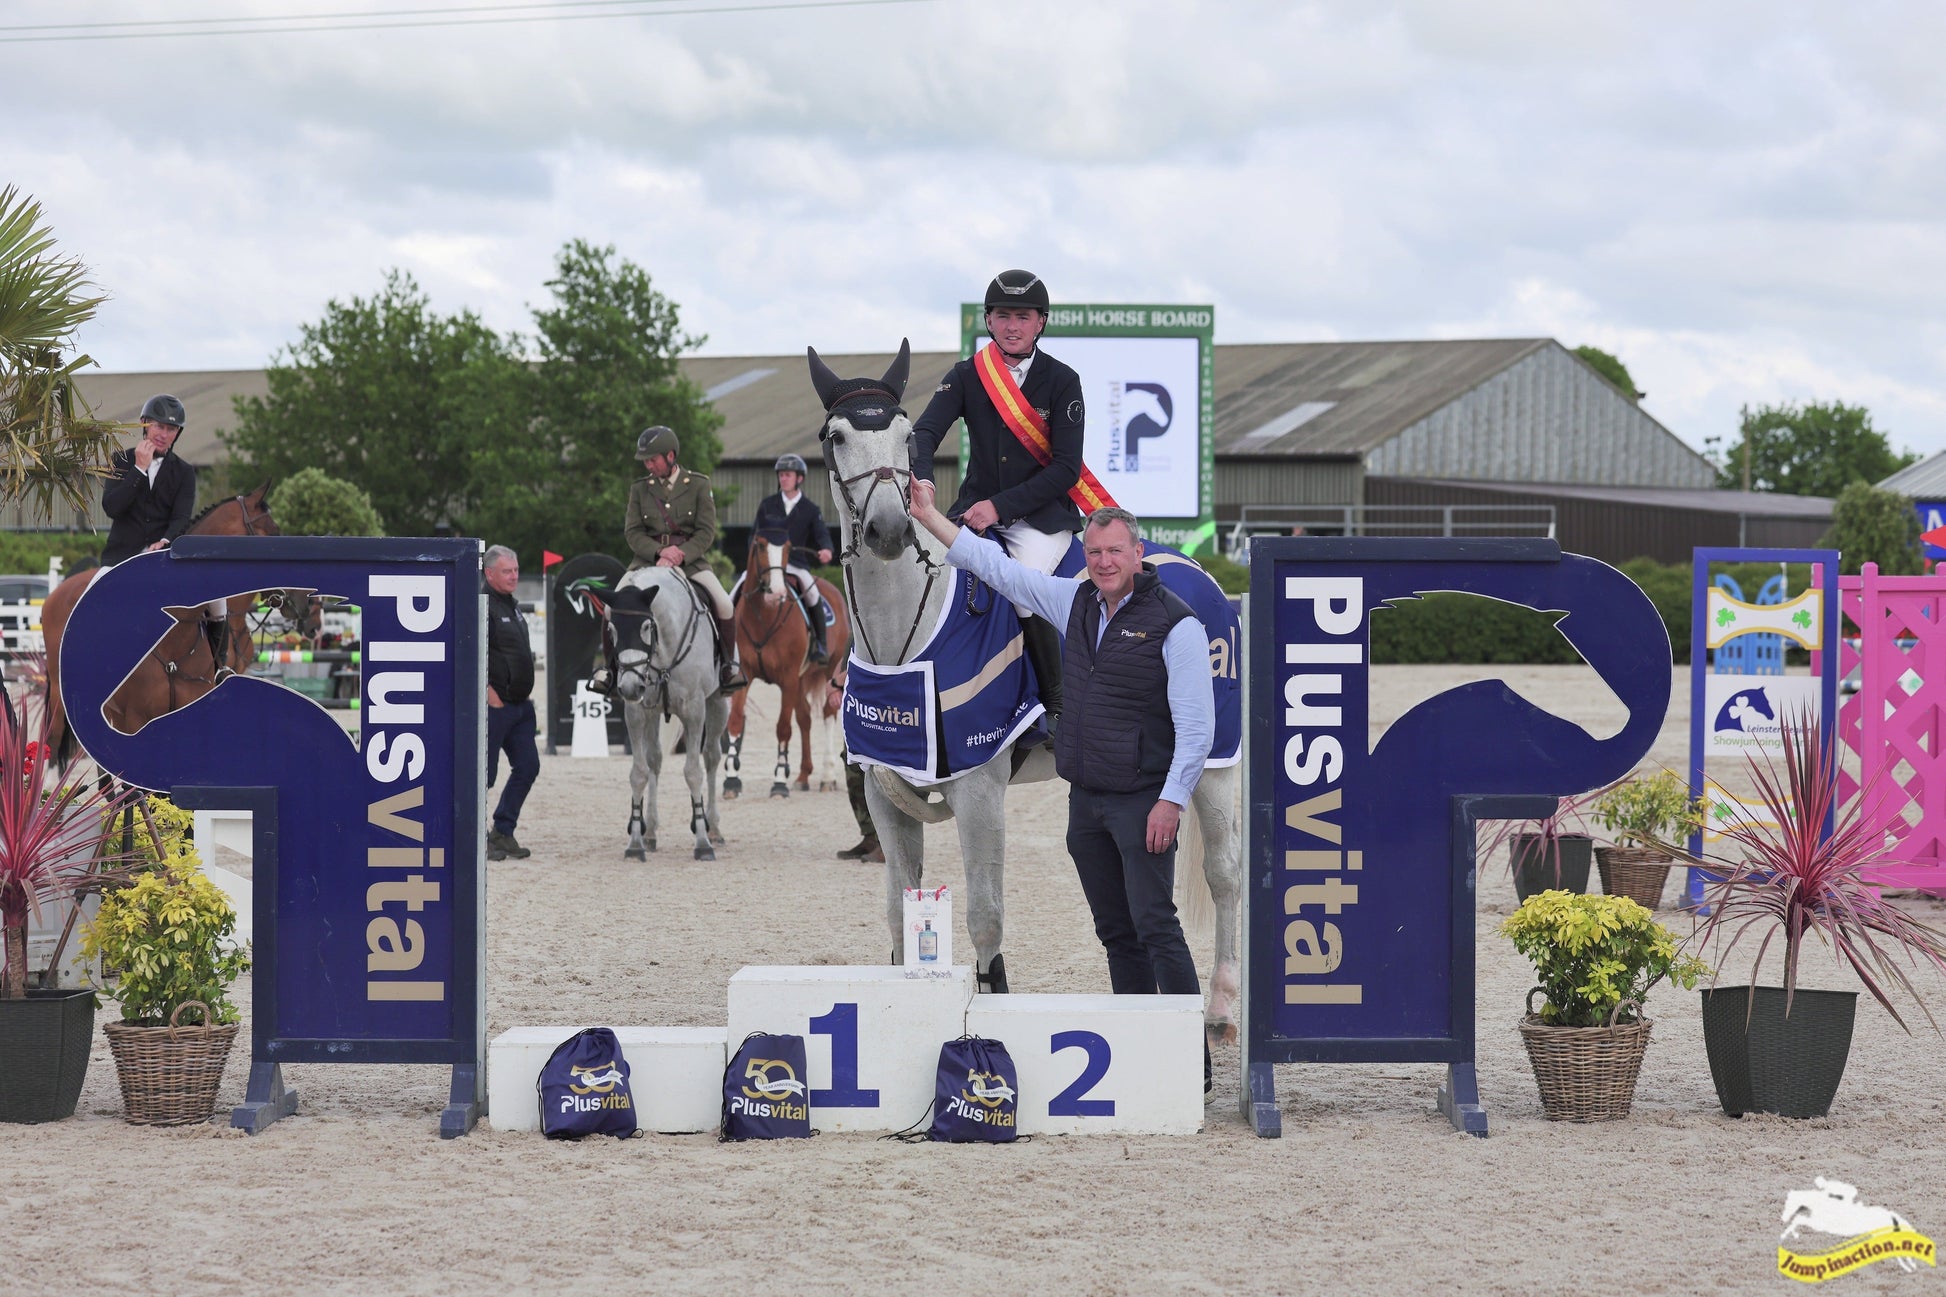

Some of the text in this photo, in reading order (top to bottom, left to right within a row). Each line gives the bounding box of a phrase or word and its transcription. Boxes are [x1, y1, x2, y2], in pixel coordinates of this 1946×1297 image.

[1048, 309, 1211, 328] RISH HORSE BOARD
[1151, 526, 1205, 545] Horses
[1121, 628, 1147, 638] Plusvital
[577, 701, 602, 718] 15
[846, 694, 919, 727] Plusvital
[861, 721, 898, 733] PLUSVITAL.COM
[1746, 724, 1781, 733] Leinster
[365, 575, 446, 1001] Plusvital
[1283, 576, 1363, 1004] Plusvital
[809, 1003, 880, 1108] 1
[742, 1058, 795, 1100] 50
[1048, 1030, 1116, 1117] 2
[561, 1092, 631, 1113] Plusvital
[731, 1096, 807, 1121] Plusvital
[946, 1095, 1015, 1127] Plusvital
